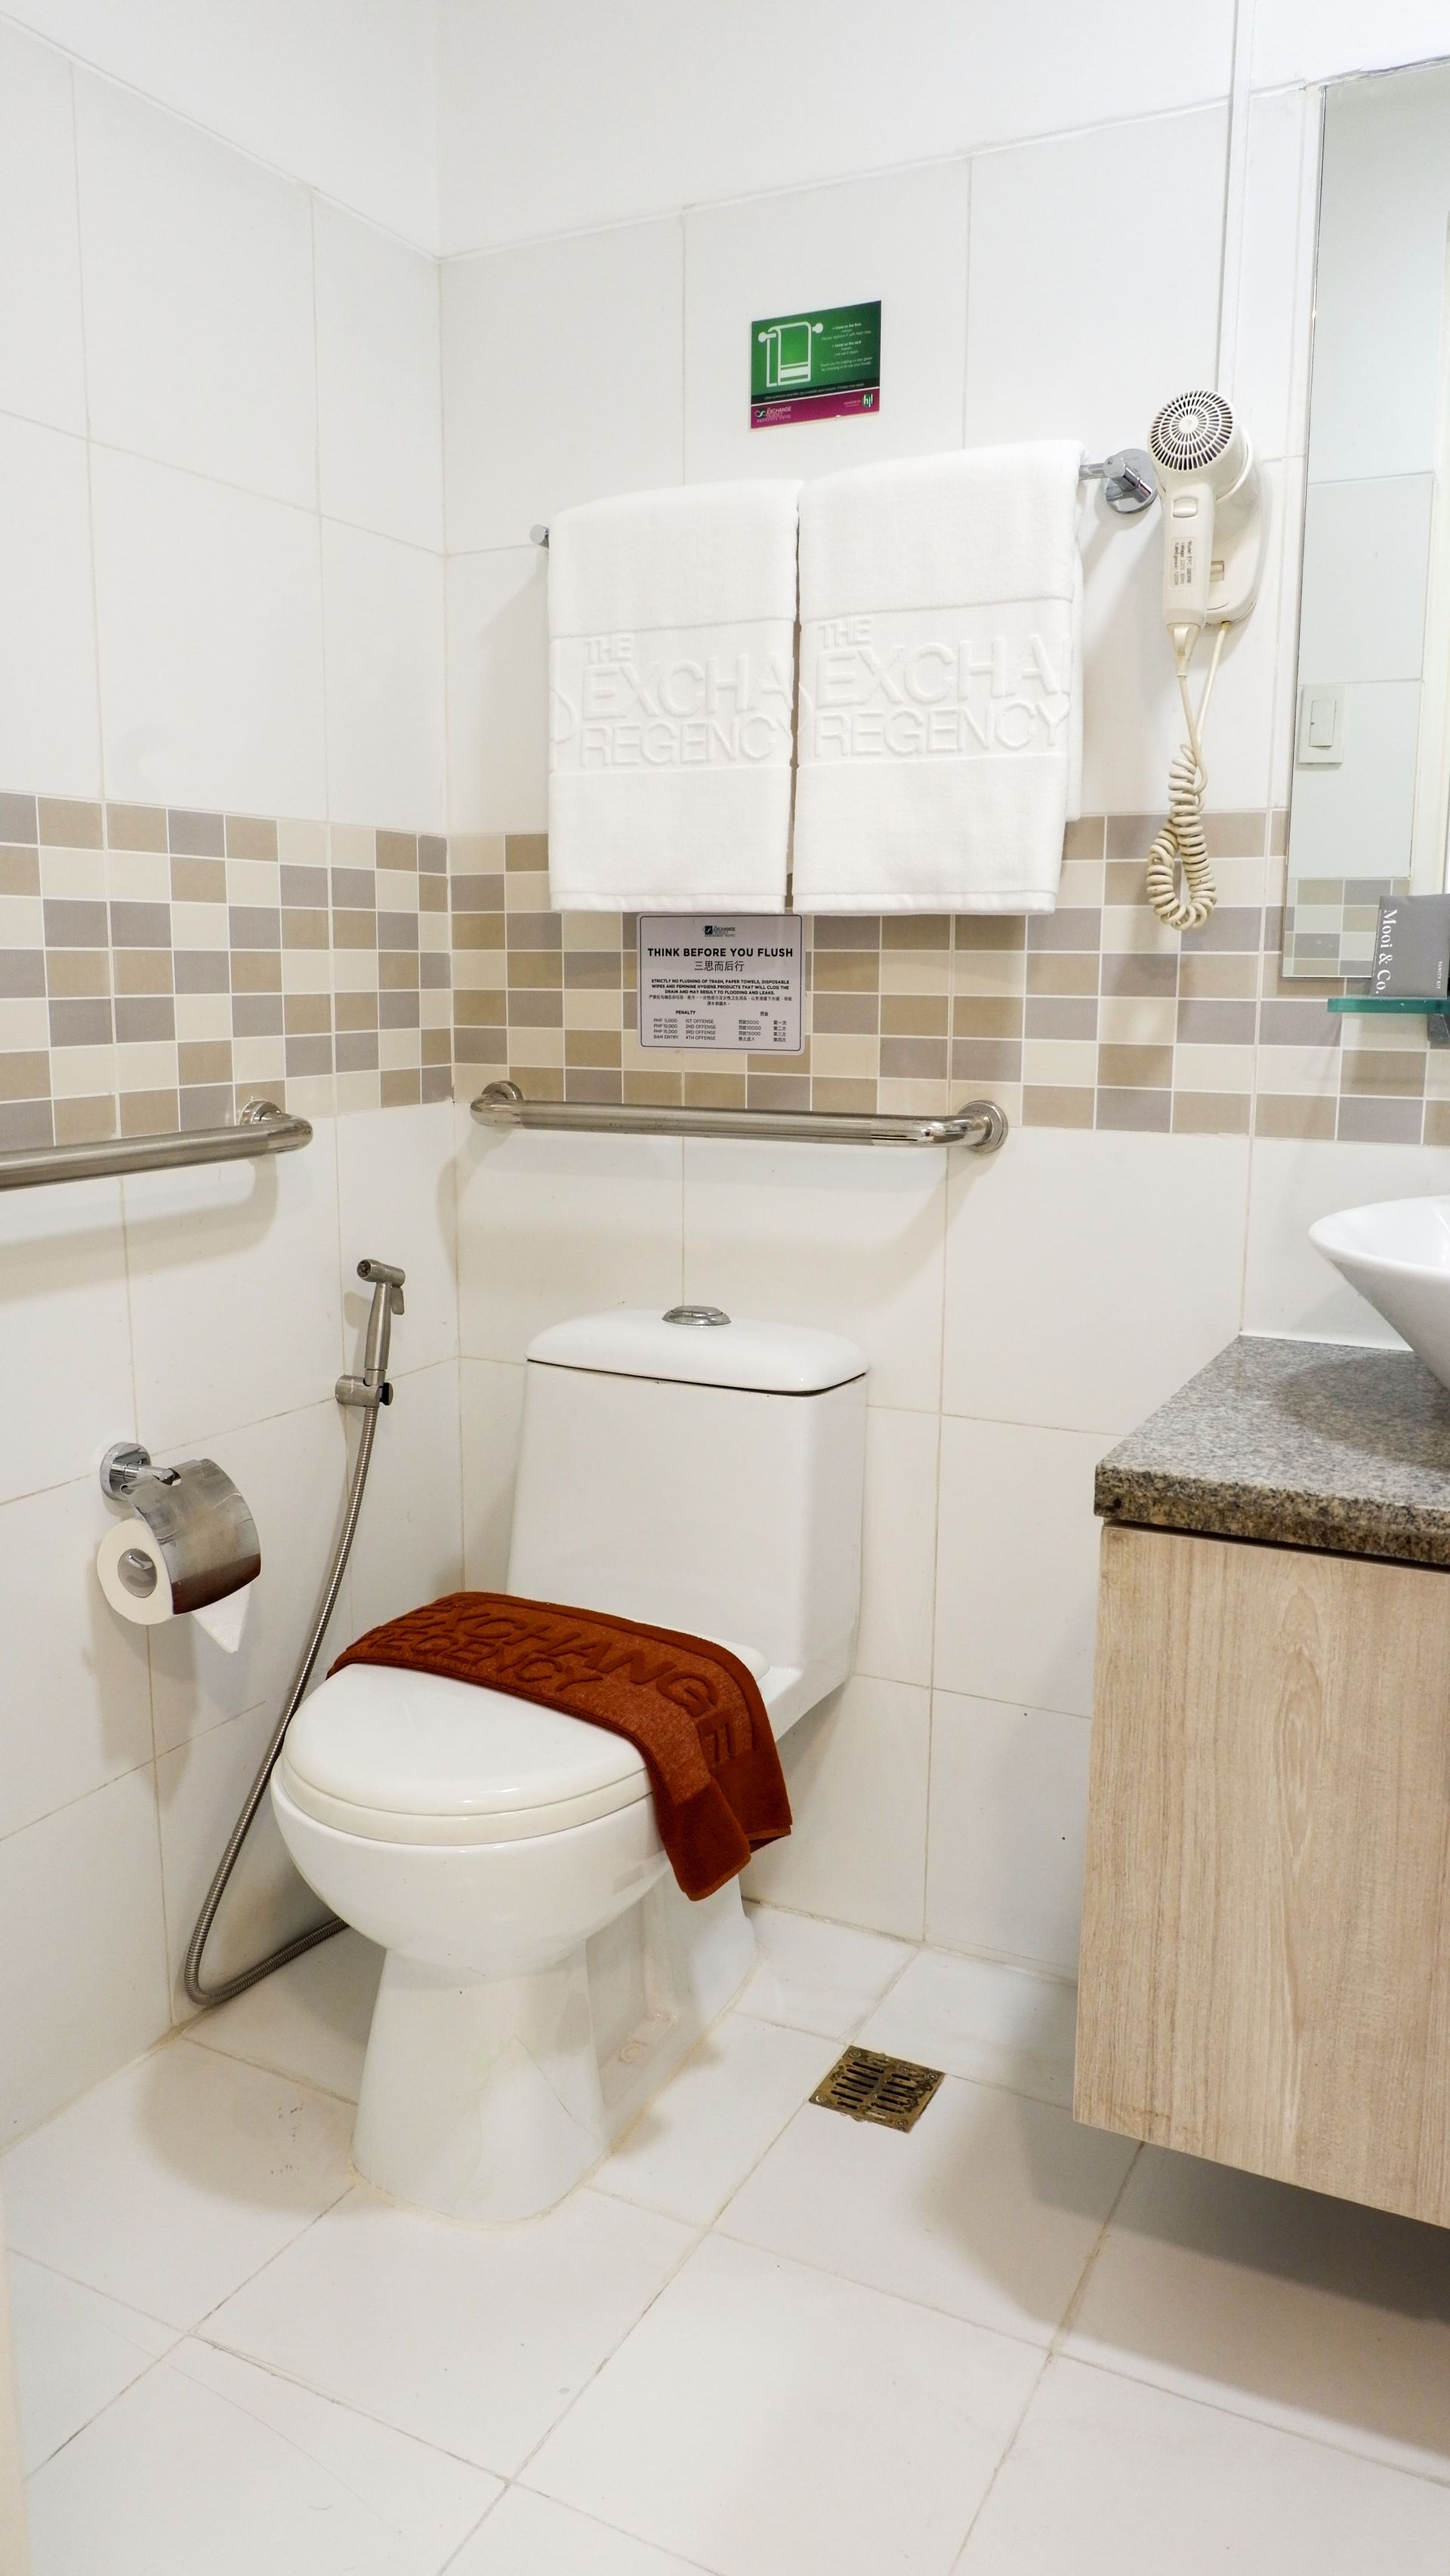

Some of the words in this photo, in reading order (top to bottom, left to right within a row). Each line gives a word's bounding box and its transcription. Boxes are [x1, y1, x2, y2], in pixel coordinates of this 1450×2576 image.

[818, 617, 872, 649] THE
[584, 633, 632, 664] THE
[814, 700, 1070, 757] REGENCY
[1381, 908, 1397, 948] Mooi
[647, 948, 680, 957] THINK
[683, 948, 727, 957] BEFORE
[730, 948, 754, 957] YOU
[757, 948, 793, 957] FLUSH
[694, 960, 745, 972] 三思而后行
[1378, 953, 1393, 965] &
[1375, 969, 1391, 994] Co.
